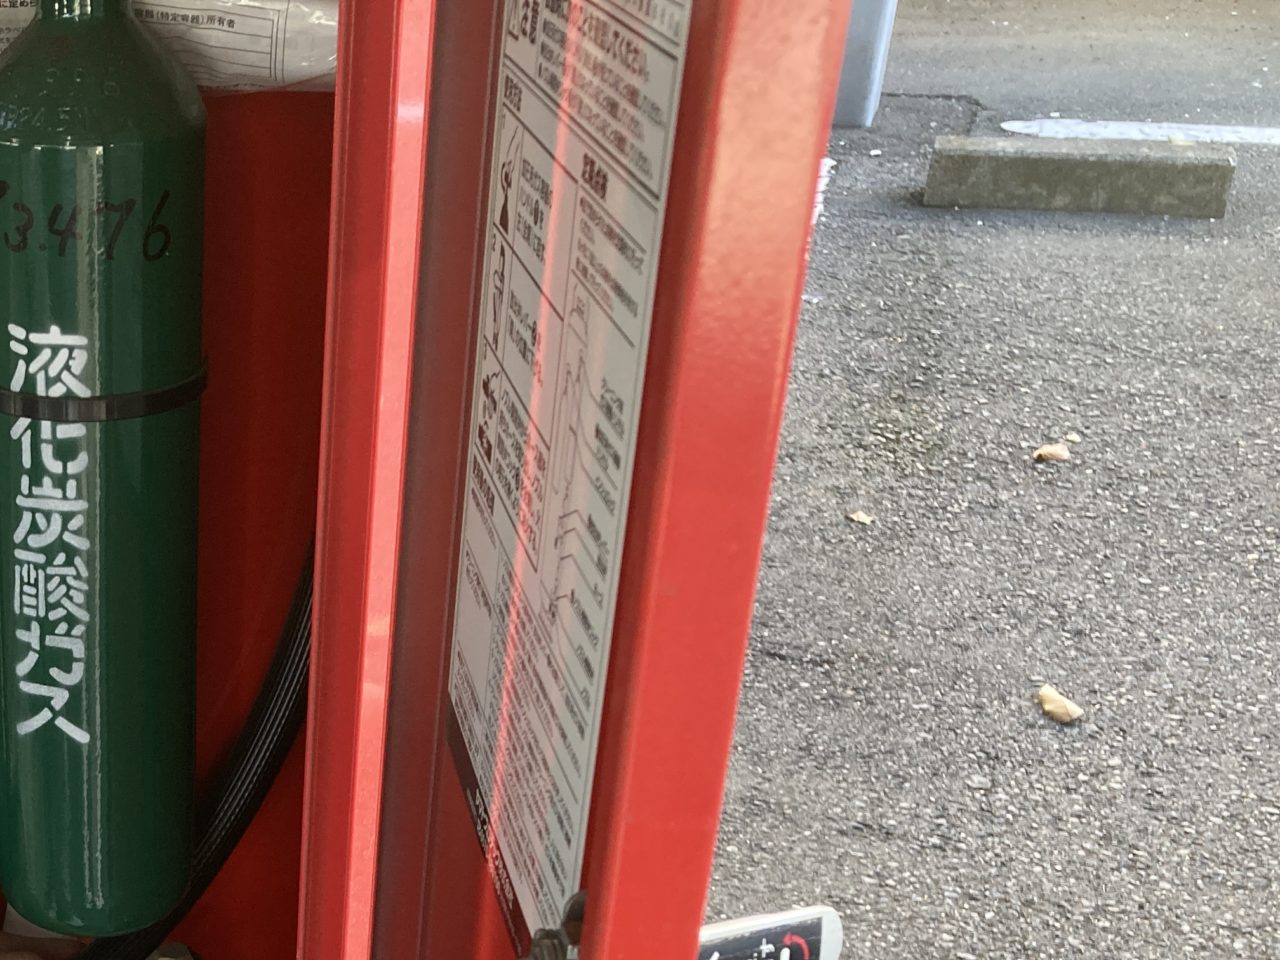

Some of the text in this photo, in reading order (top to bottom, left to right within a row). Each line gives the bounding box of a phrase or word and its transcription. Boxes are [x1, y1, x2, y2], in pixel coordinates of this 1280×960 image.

[8, 323, 91, 744] 液化炭酸ガス
